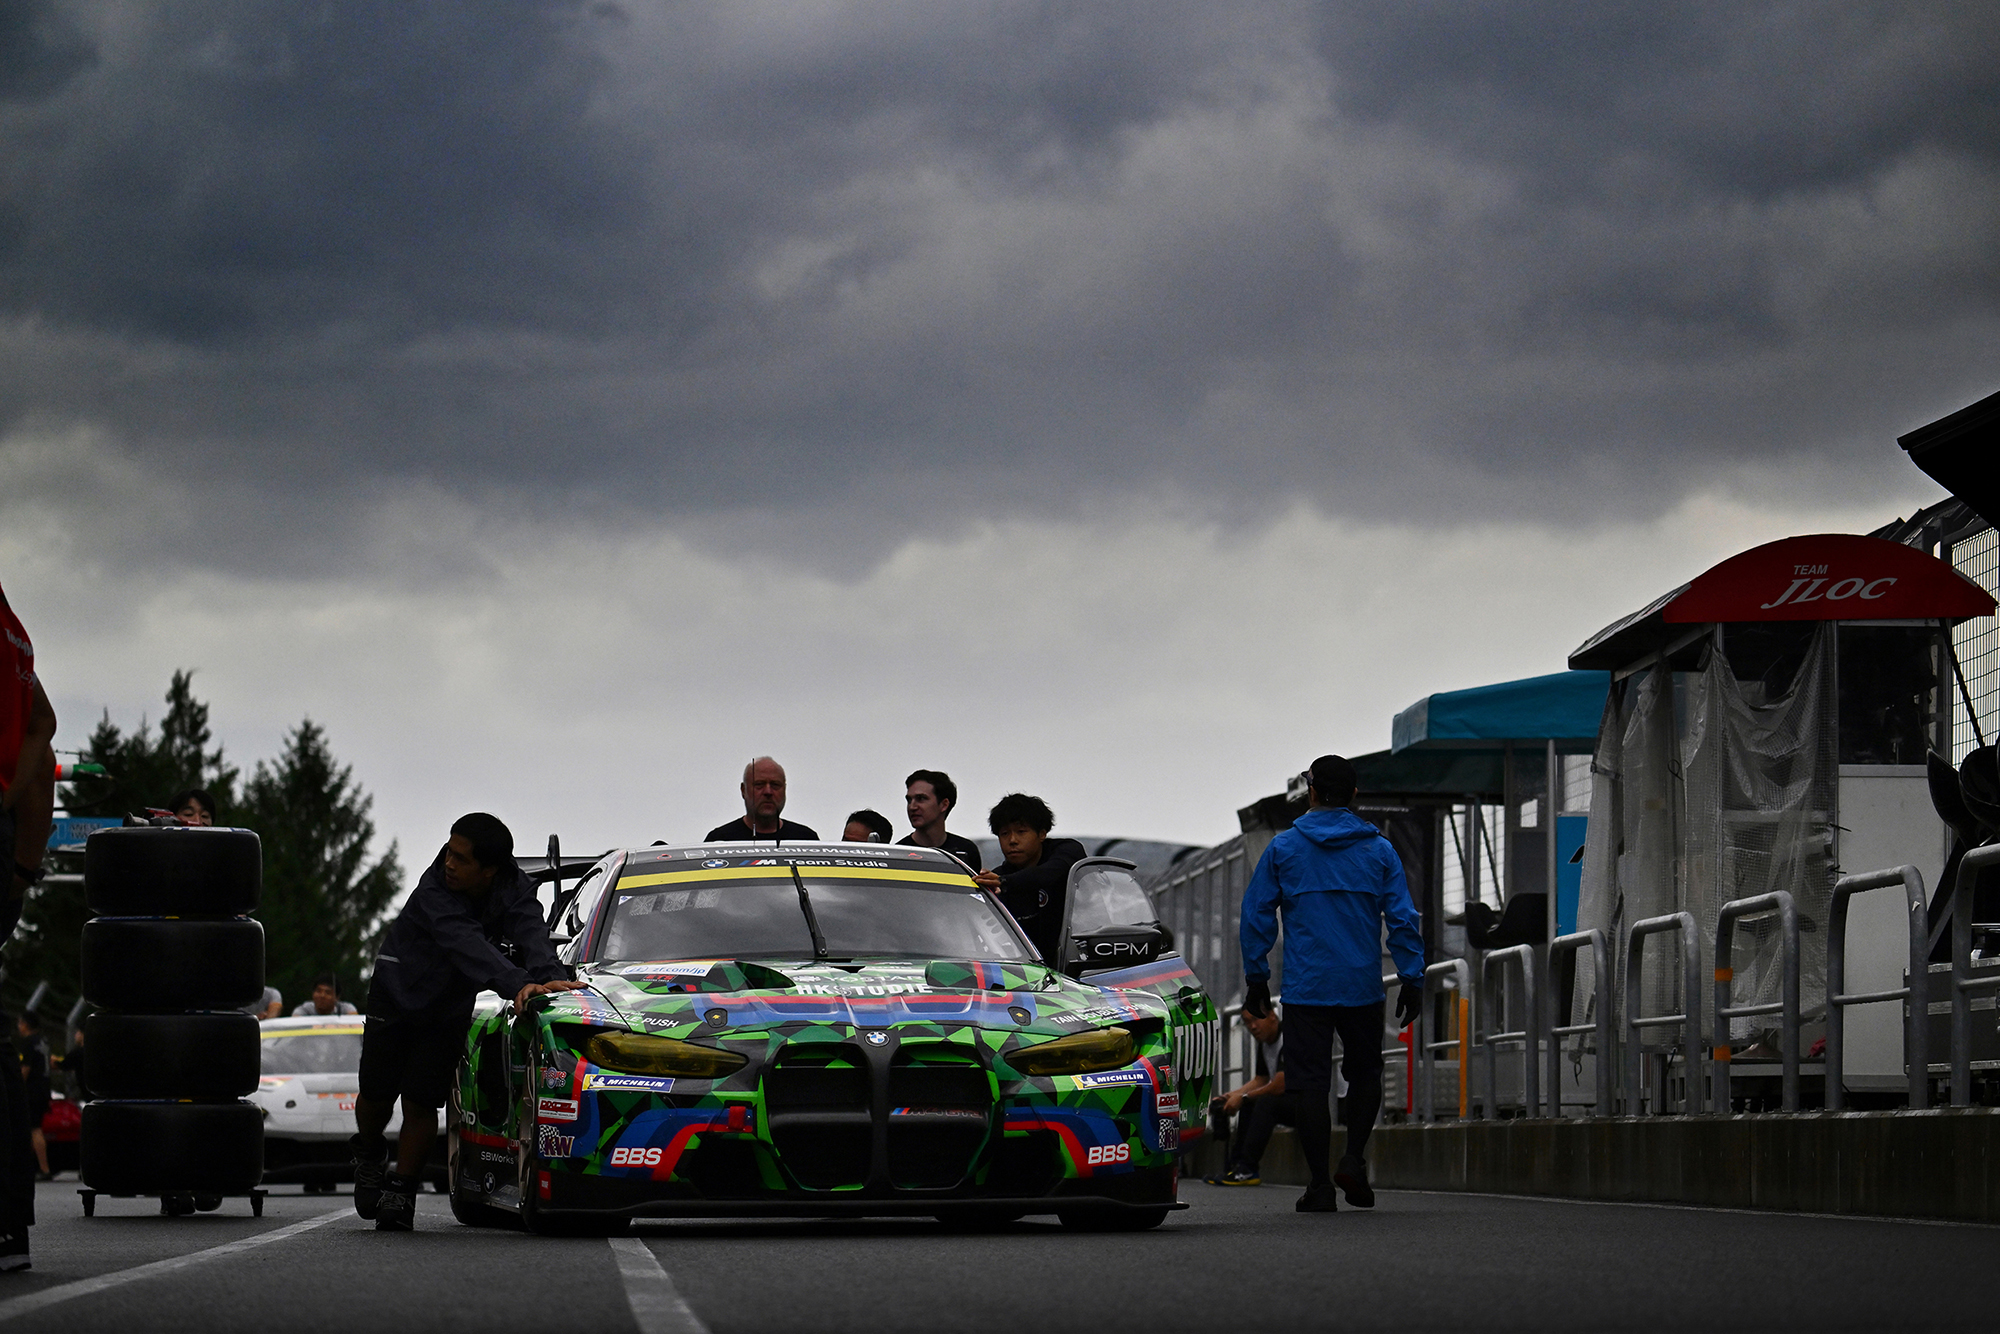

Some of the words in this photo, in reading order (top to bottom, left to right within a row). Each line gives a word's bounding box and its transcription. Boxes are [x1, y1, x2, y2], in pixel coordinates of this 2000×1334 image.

[1794, 564, 1828, 575] TEAM
[1760, 577, 1898, 609] JLOC
[835, 860, 888, 868] Studie
[1094, 942, 1149, 956] CPM
[557, 1007, 586, 1015] TAIN
[642, 1017, 680, 1028] PUSH
[606, 1078, 666, 1088] MICHELIN
[1097, 1073, 1144, 1083] MICHELIN
[544, 1135, 575, 1158] KW
[1087, 1142, 1130, 1165] BBS
[480, 1150, 515, 1165] SBWorks
[610, 1147, 663, 1166] BBS
